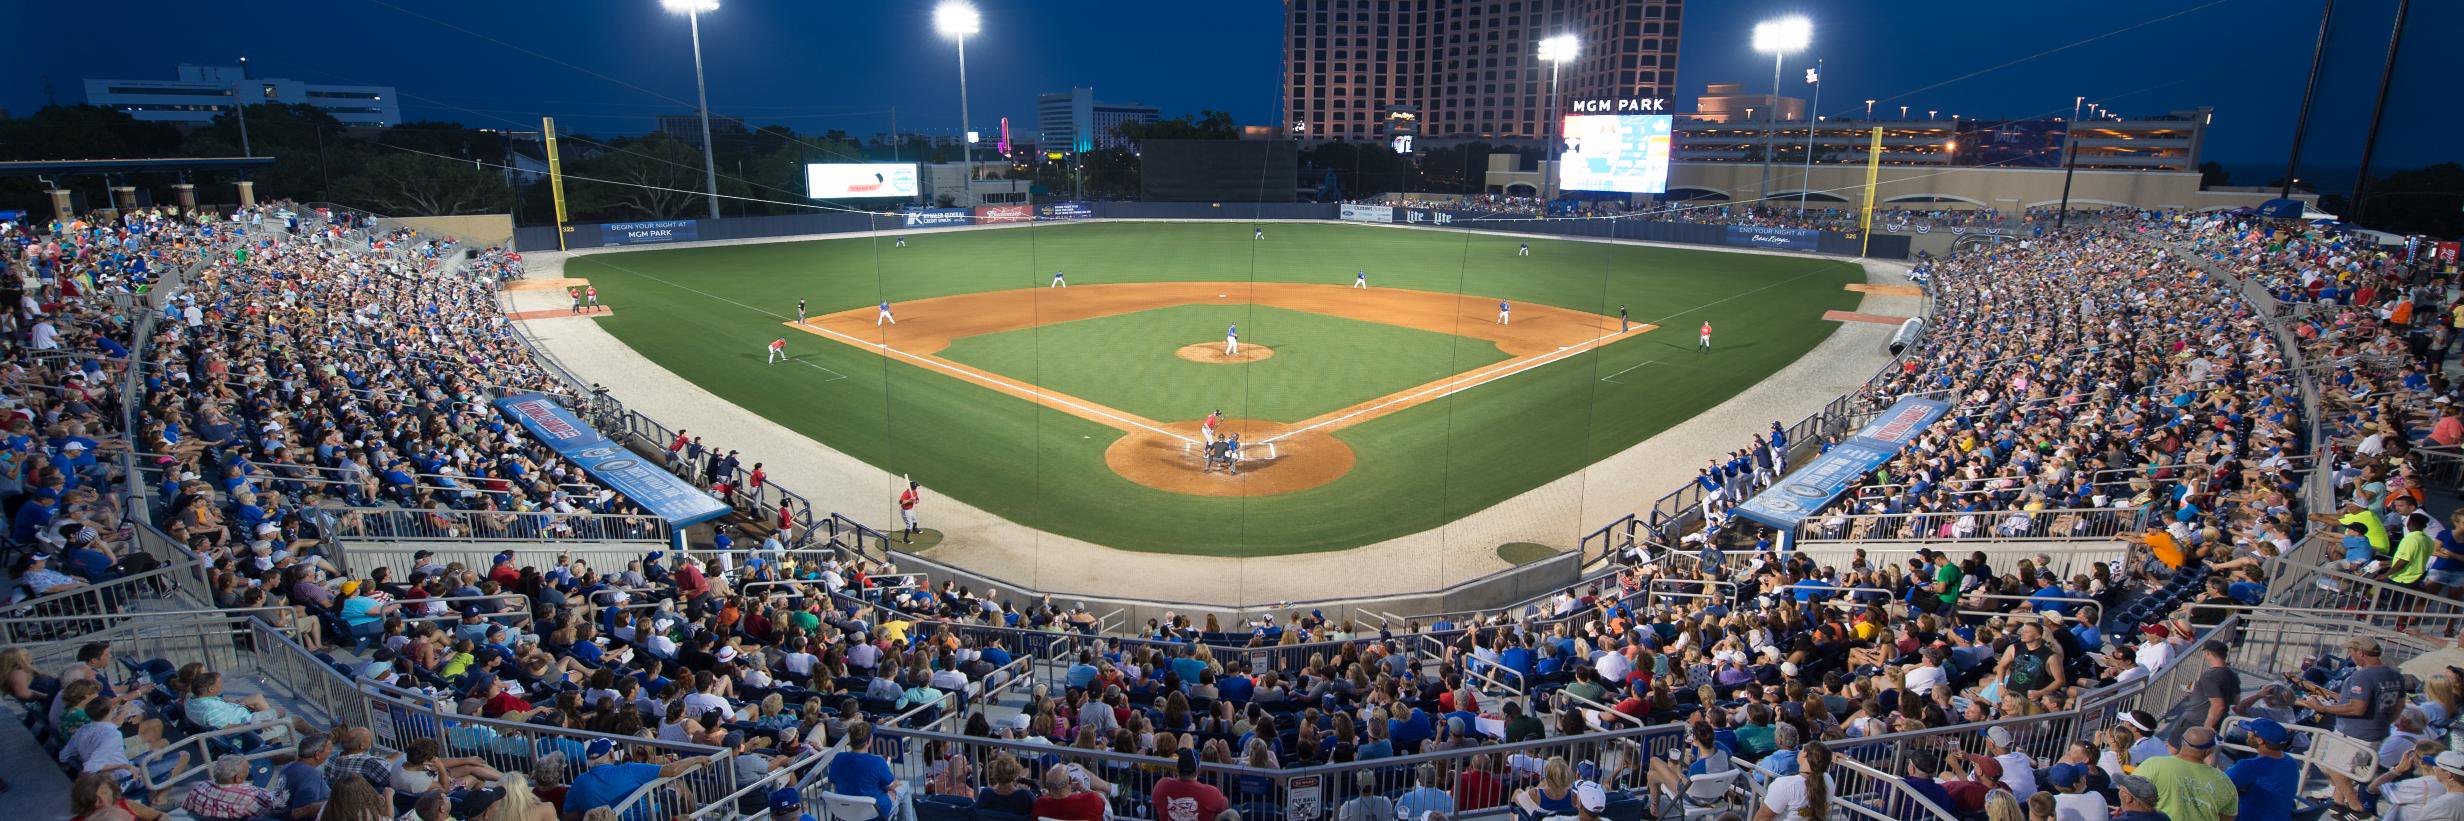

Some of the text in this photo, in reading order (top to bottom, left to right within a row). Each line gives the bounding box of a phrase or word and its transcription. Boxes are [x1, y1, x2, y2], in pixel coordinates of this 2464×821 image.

[1573, 98, 1665, 112] MGM PARK
[1406, 210, 1424, 224] Lite
[1433, 211, 1452, 225] Lite
[611, 223, 633, 231] BEGIN
[635, 222, 655, 230] YOUR
[650, 229, 672, 237] PARK
[1774, 228, 1796, 236] NIGHT
[1028, 634, 1045, 648] 102
[1649, 734, 1679, 757] 100
